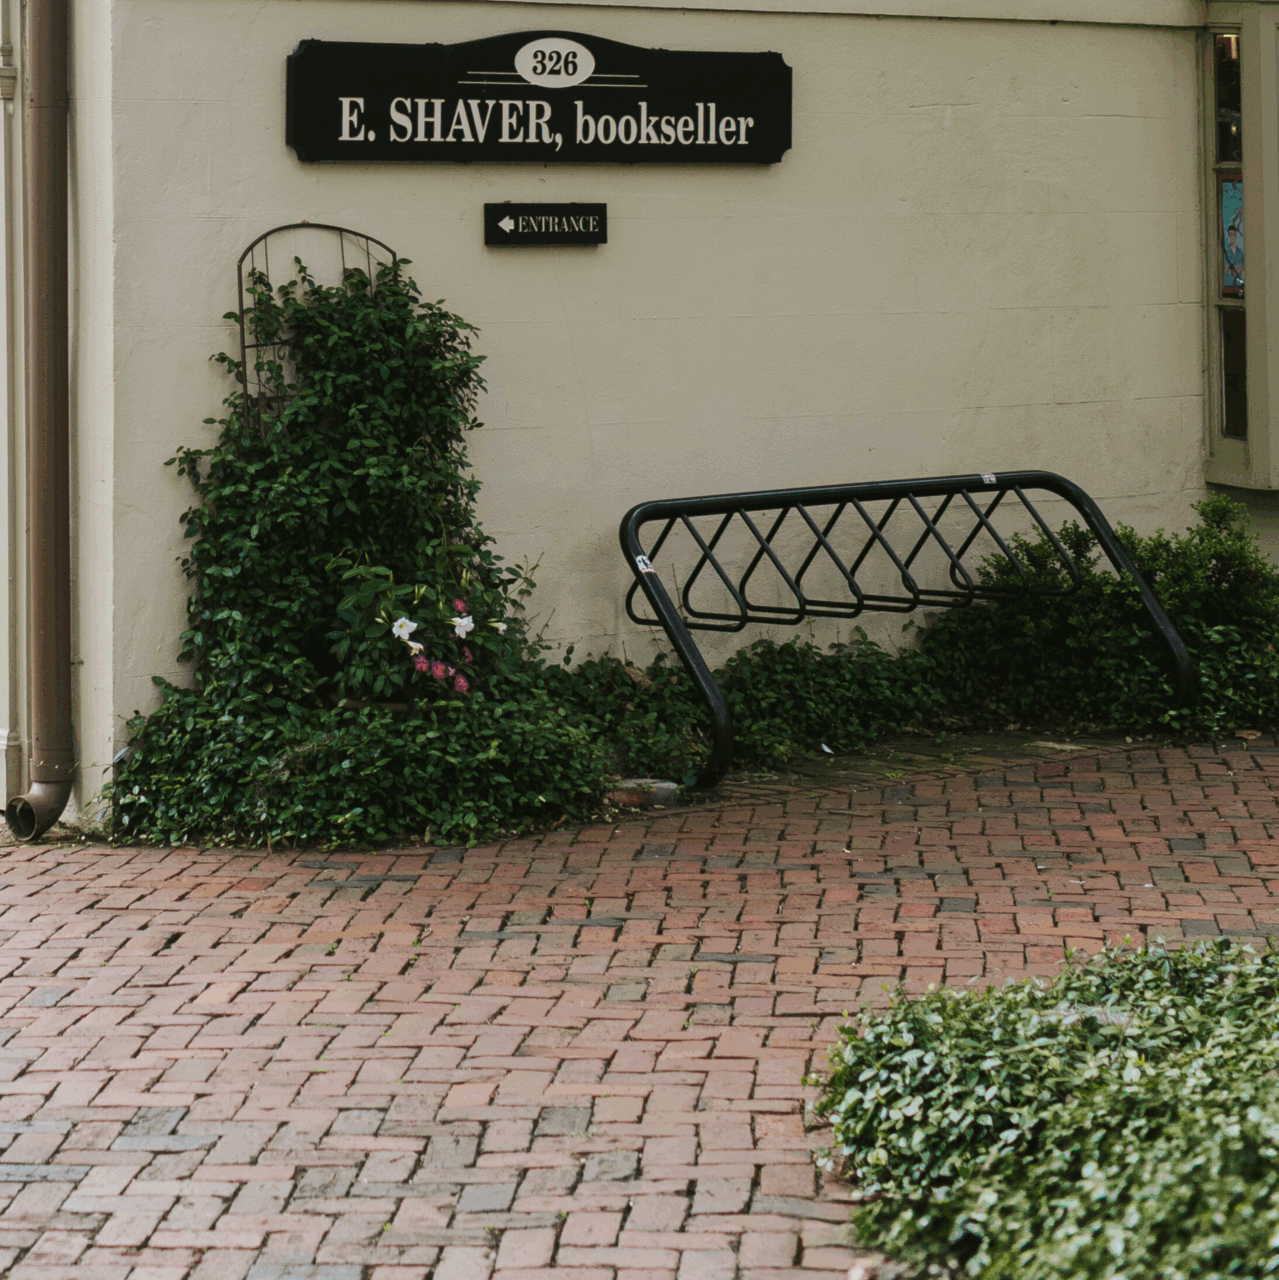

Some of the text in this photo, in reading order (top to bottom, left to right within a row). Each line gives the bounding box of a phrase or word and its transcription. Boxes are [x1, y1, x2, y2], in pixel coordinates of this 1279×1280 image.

[532, 50, 578, 77] 326
[338, 97, 754, 152] E. SHAVER, bookseller
[518, 216, 599, 234] ENTRANCE
